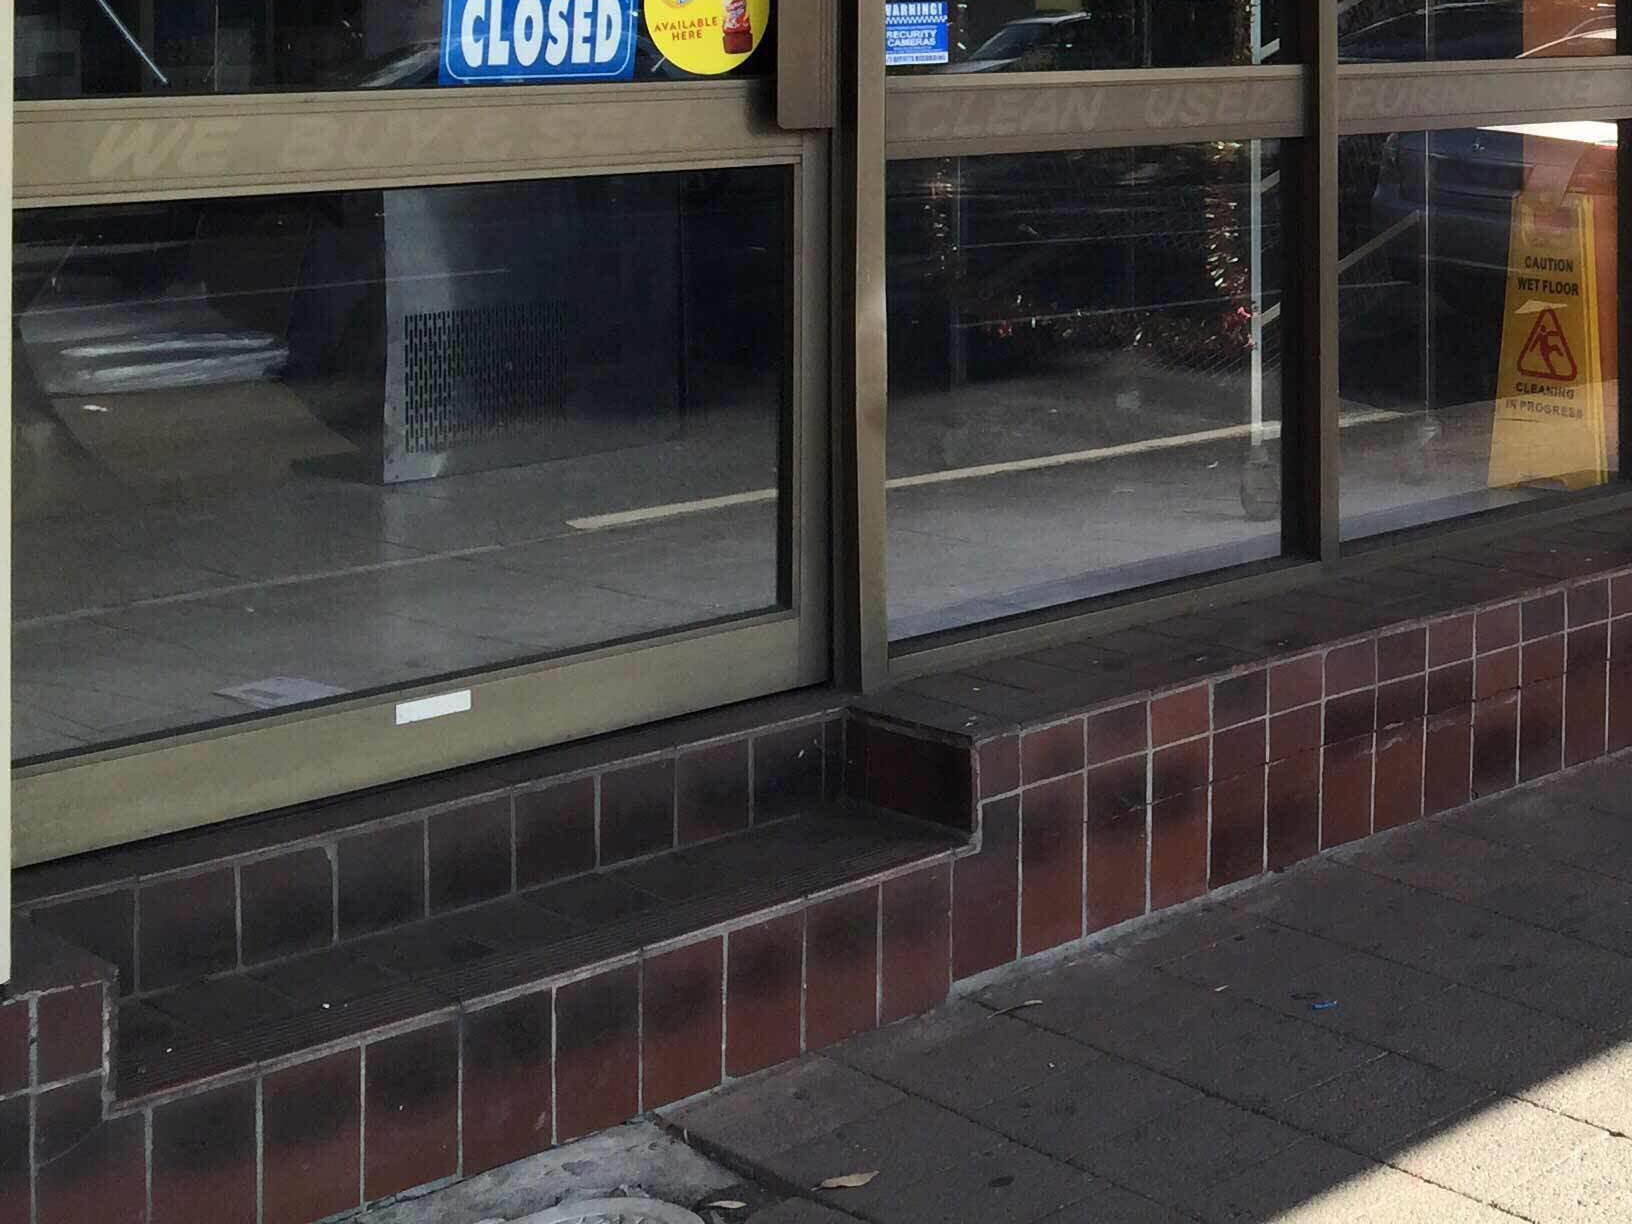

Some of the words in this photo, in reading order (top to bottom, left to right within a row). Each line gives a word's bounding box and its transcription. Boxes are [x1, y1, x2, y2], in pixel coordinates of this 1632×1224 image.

[654, 17, 718, 32] AVAILABLE
[672, 31, 702, 41] HERE
[88, 119, 240, 177] WE
[1146, 80, 1282, 126] USED
[1524, 255, 1573, 273] CAUTION
[1517, 278, 1540, 292] WET
[1542, 279, 1579, 296] FLOOR
[1516, 382, 1575, 400] CLEANING
[1505, 398, 1517, 410] IN
[1520, 400, 1583, 419] PROGRESS
